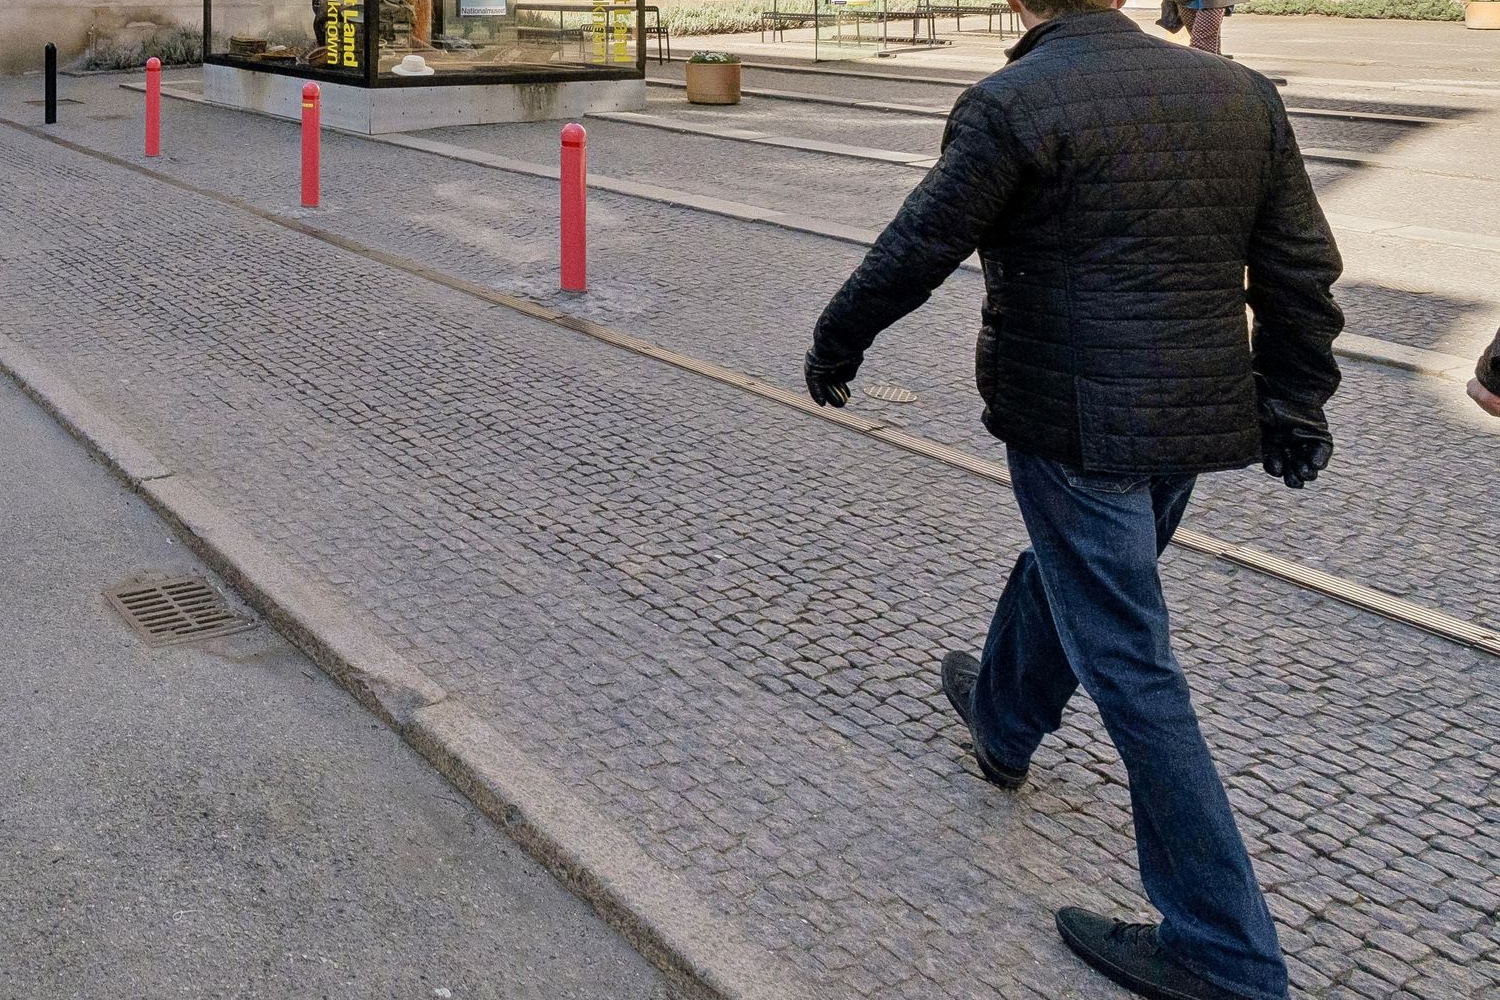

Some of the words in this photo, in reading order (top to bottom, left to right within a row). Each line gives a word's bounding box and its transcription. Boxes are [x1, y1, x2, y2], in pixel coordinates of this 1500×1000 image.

[461, 7, 506, 15] Nationalmuseet
[613, 9, 632, 63] Land
[343, 10, 359, 68] Land
